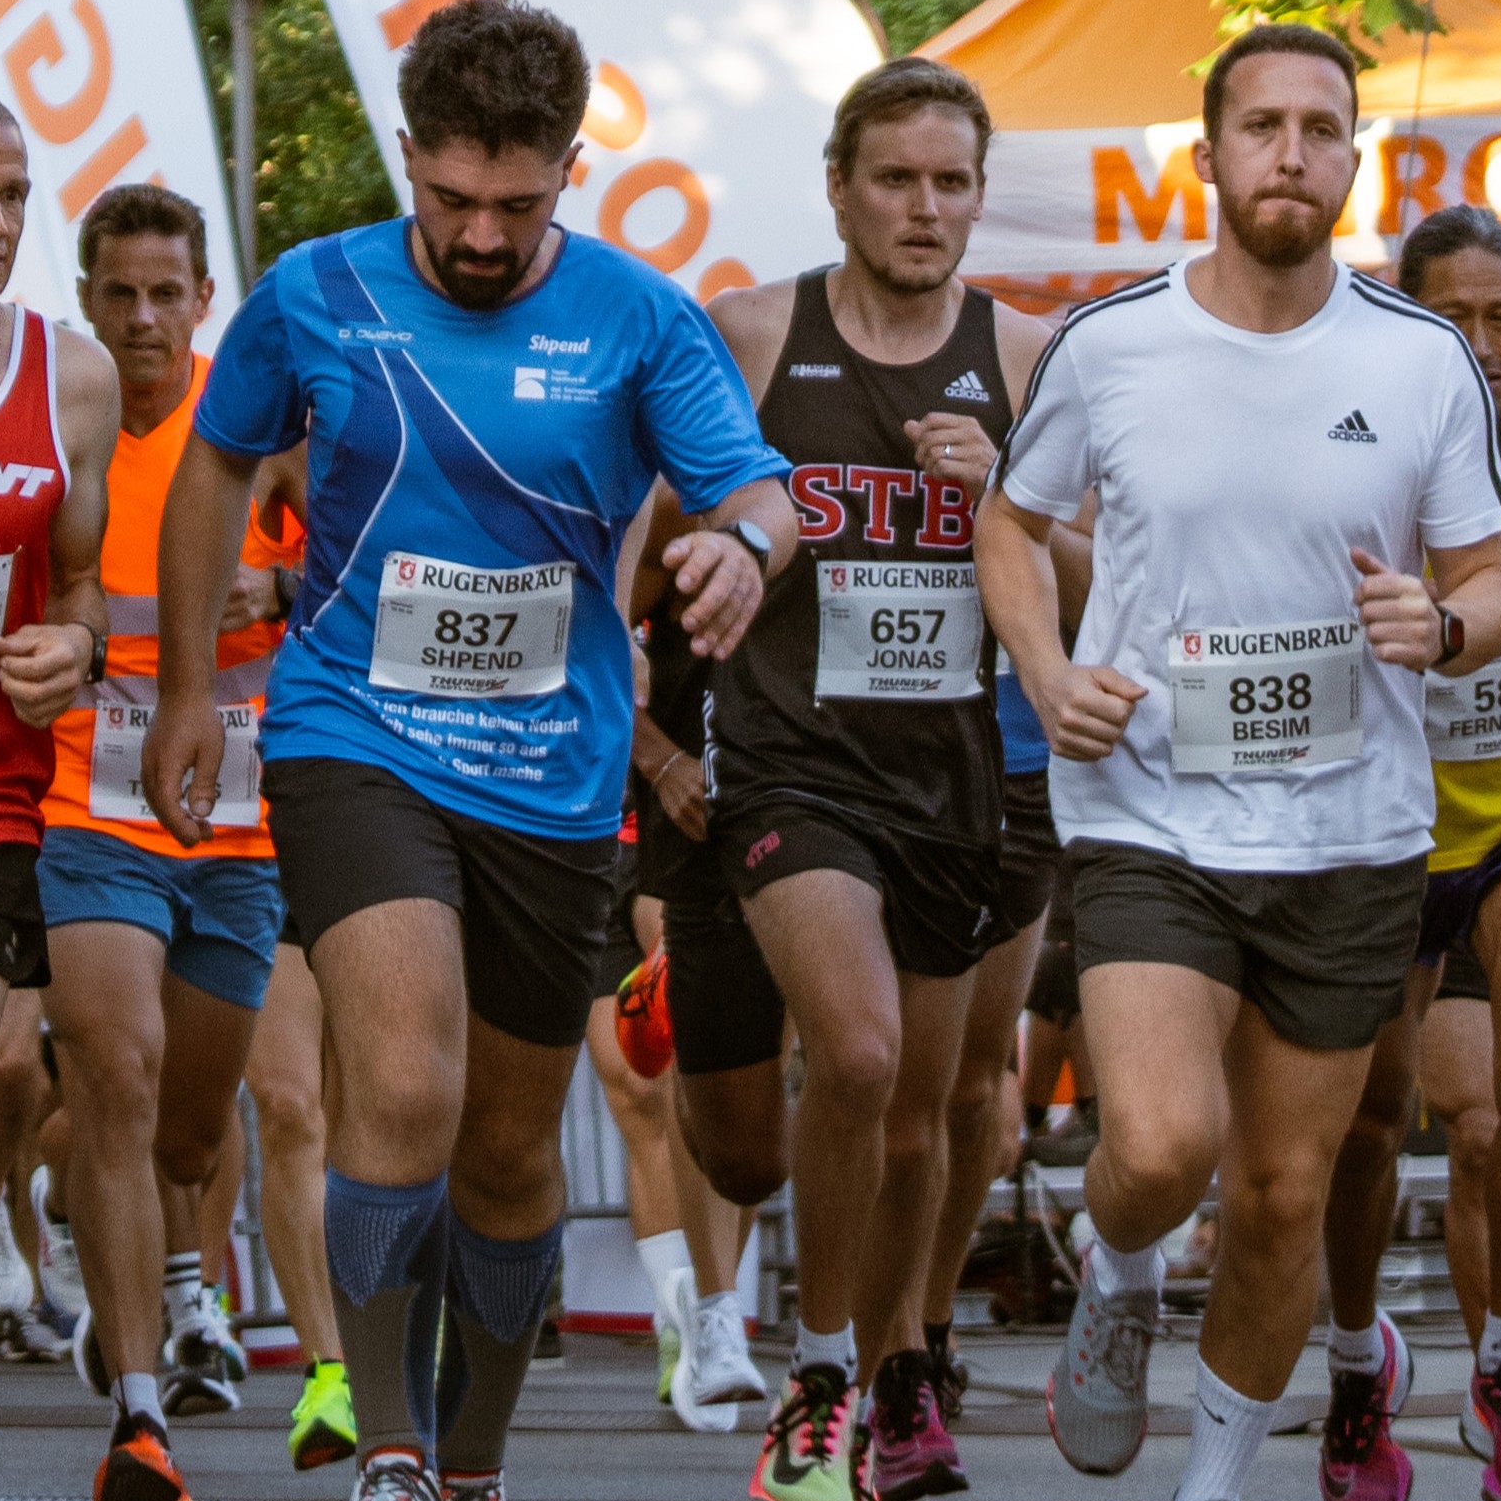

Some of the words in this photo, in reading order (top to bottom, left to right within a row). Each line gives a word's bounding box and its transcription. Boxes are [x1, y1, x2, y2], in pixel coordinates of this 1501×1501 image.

[529, 335, 591, 356] Shpend
[944, 386, 989, 402] adidas
[1328, 429, 1377, 443] adidas
[789, 463, 975, 549] STB
[422, 563, 564, 594] RUGENBRÄU
[434, 609, 519, 647] 837
[870, 608, 946, 644] 657
[1209, 623, 1354, 656] RUGENBRÄU
[421, 647, 523, 670] SHPEND
[867, 650, 947, 669] JONAS
[430, 675, 498, 687] THUNER
[1229, 672, 1312, 714] 838
[411, 704, 475, 726] brauche
[1233, 716, 1311, 741] BESIM
[408, 727, 443, 747] sehe
[448, 733, 496, 755] immer
[499, 741, 516, 756] so
[520, 744, 547, 758] aus
[493, 765, 544, 782] mache
